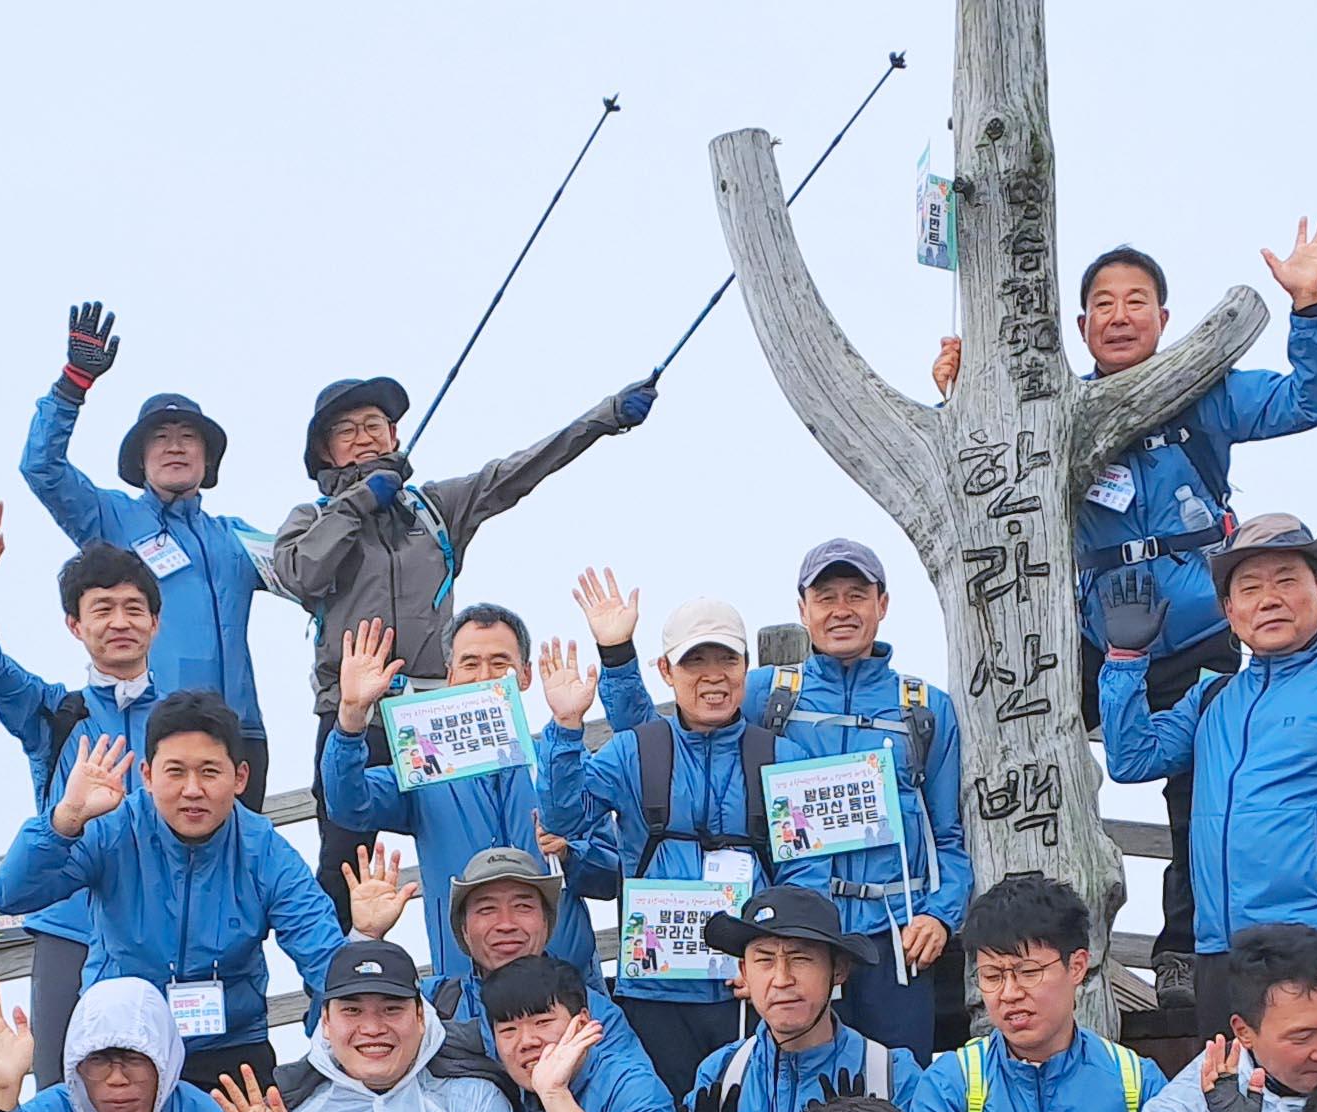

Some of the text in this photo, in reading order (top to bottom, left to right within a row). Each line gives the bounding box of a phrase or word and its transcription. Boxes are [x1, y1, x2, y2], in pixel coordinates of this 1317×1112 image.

[958, 429, 1062, 880] 한라산백
[659, 910, 711, 924] 발달장애
[672, 941, 725, 955] 프로젝
